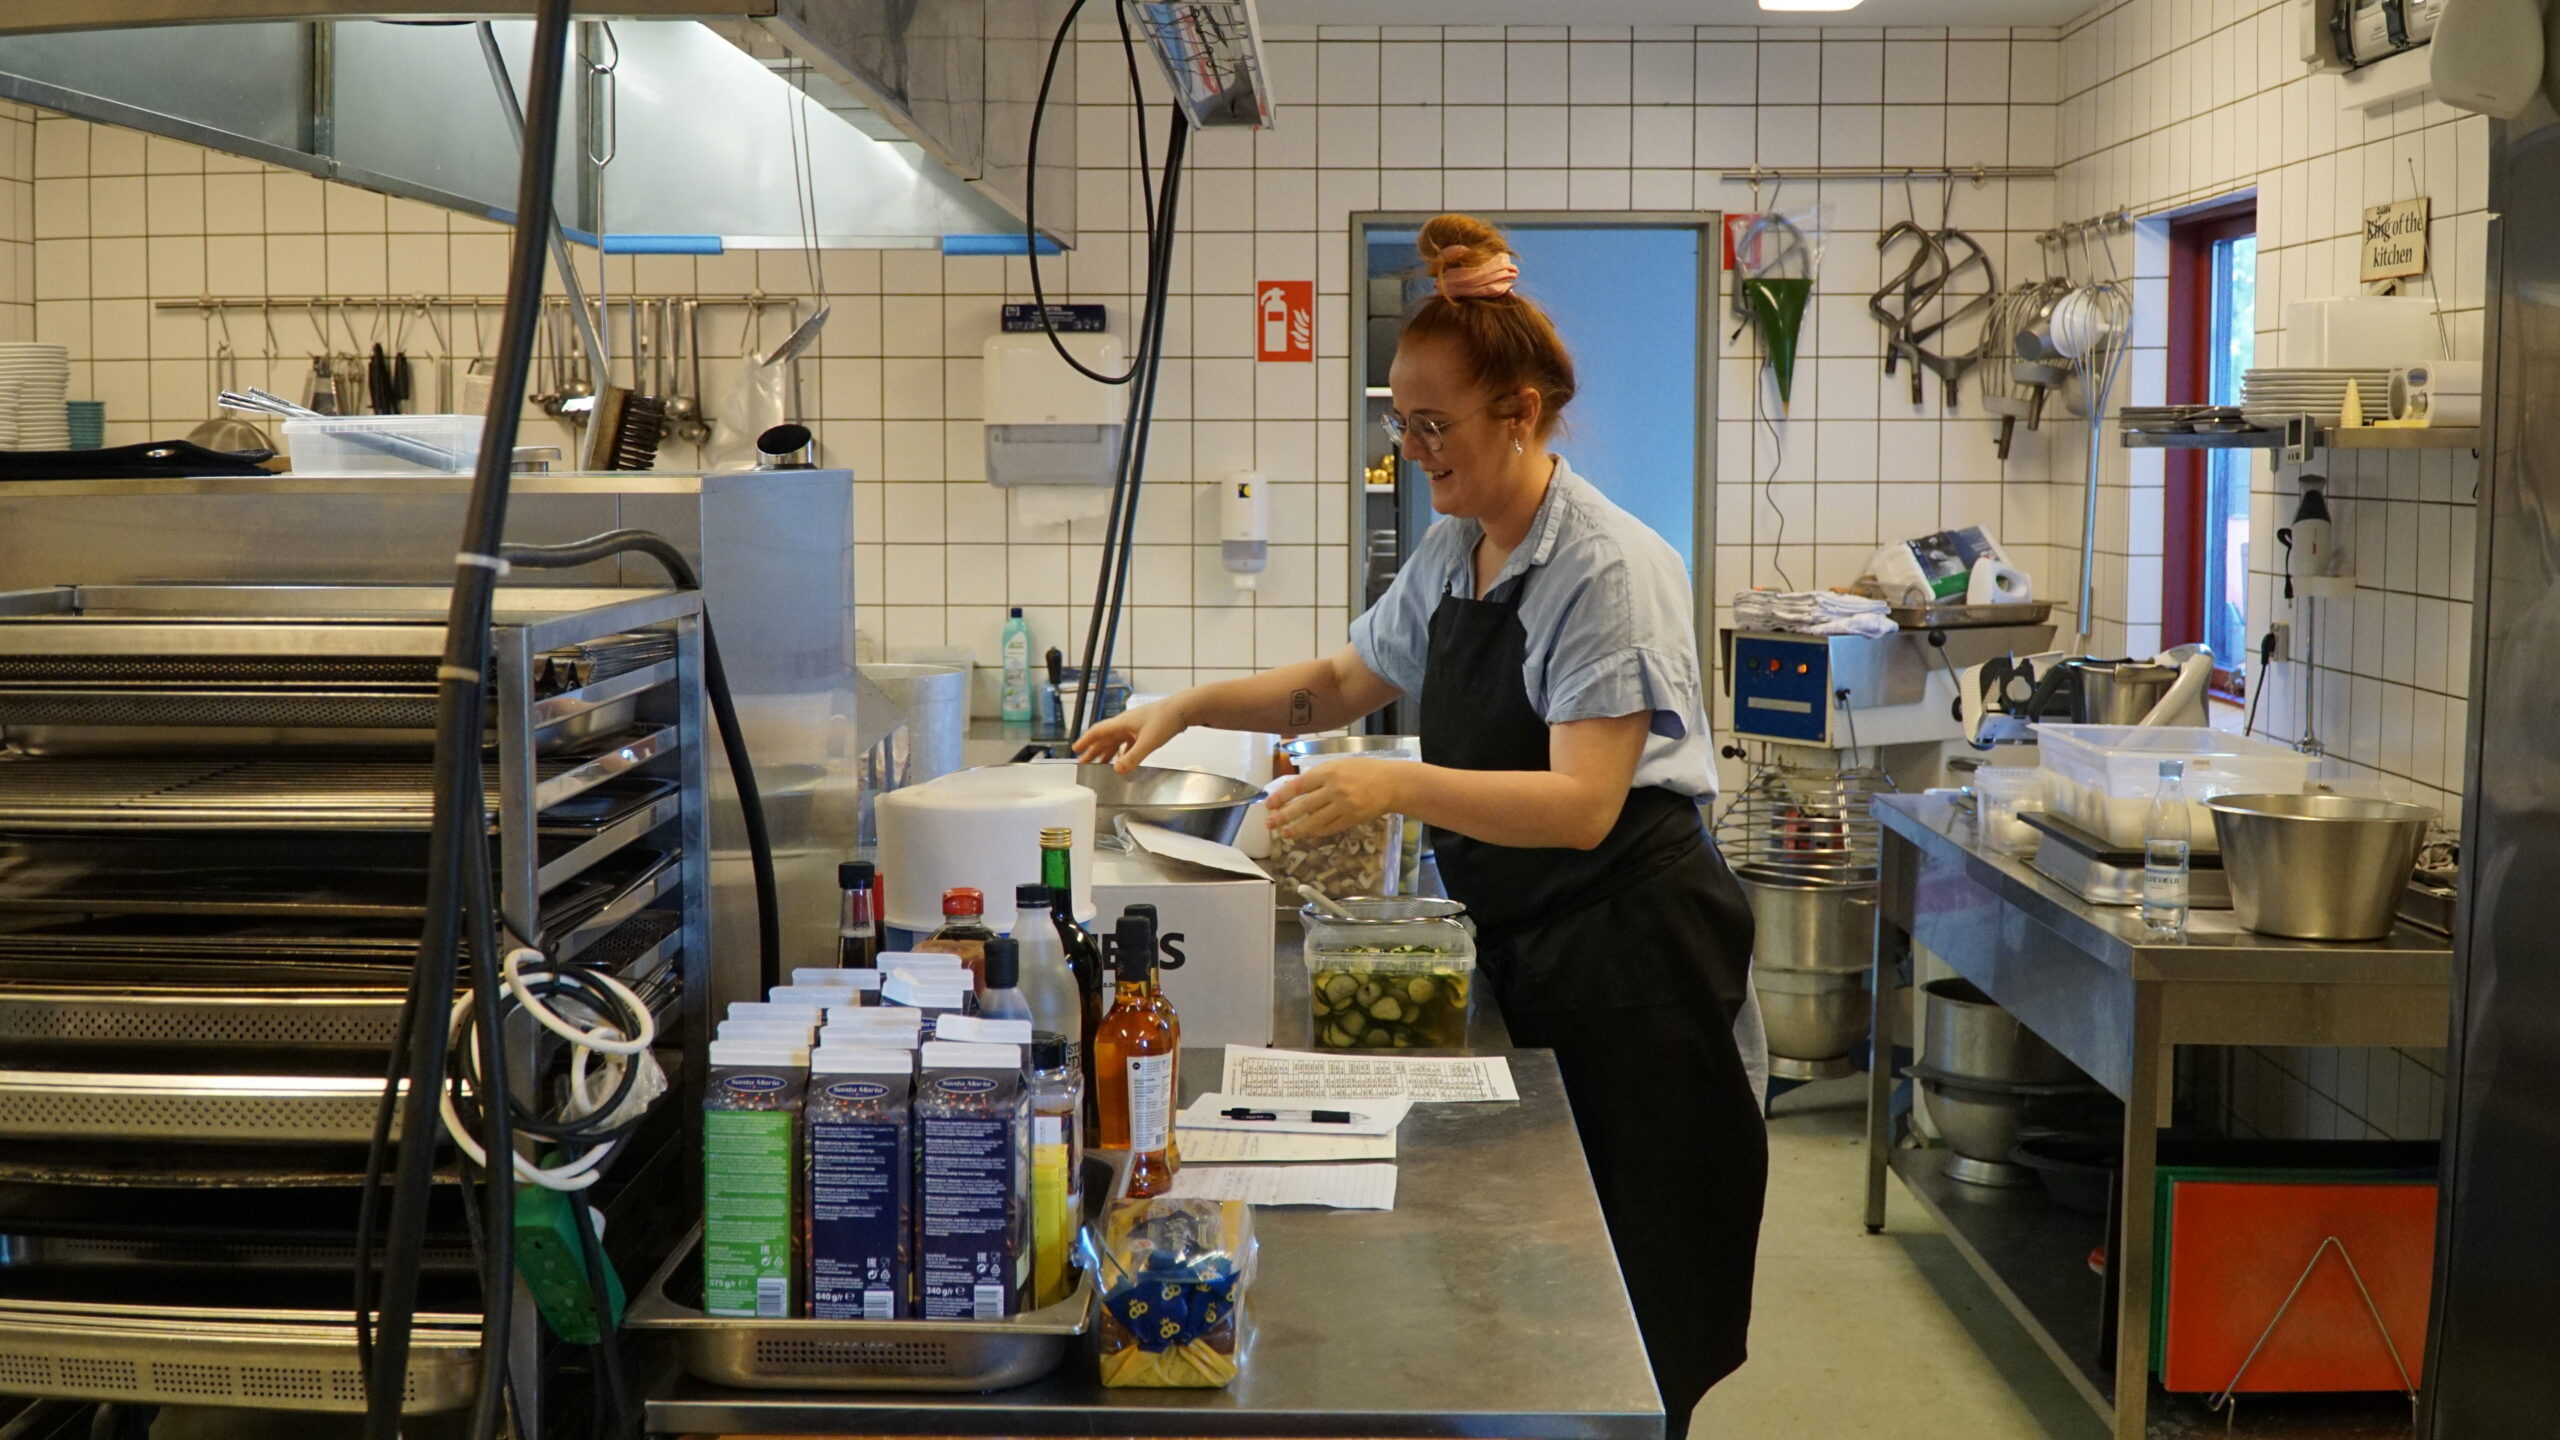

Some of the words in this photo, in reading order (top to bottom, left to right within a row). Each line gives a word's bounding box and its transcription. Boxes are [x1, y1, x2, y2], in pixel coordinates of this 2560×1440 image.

[2392, 212, 2404, 236] of
[2405, 211, 2423, 234] the
[2373, 243, 2413, 269] kitchen
[730, 1078, 755, 1087] Santa
[756, 1078, 781, 1087] Maria
[967, 1080, 992, 1088] Maria
[832, 1086, 857, 1094] Santa
[858, 1086, 884, 1094] Maria
